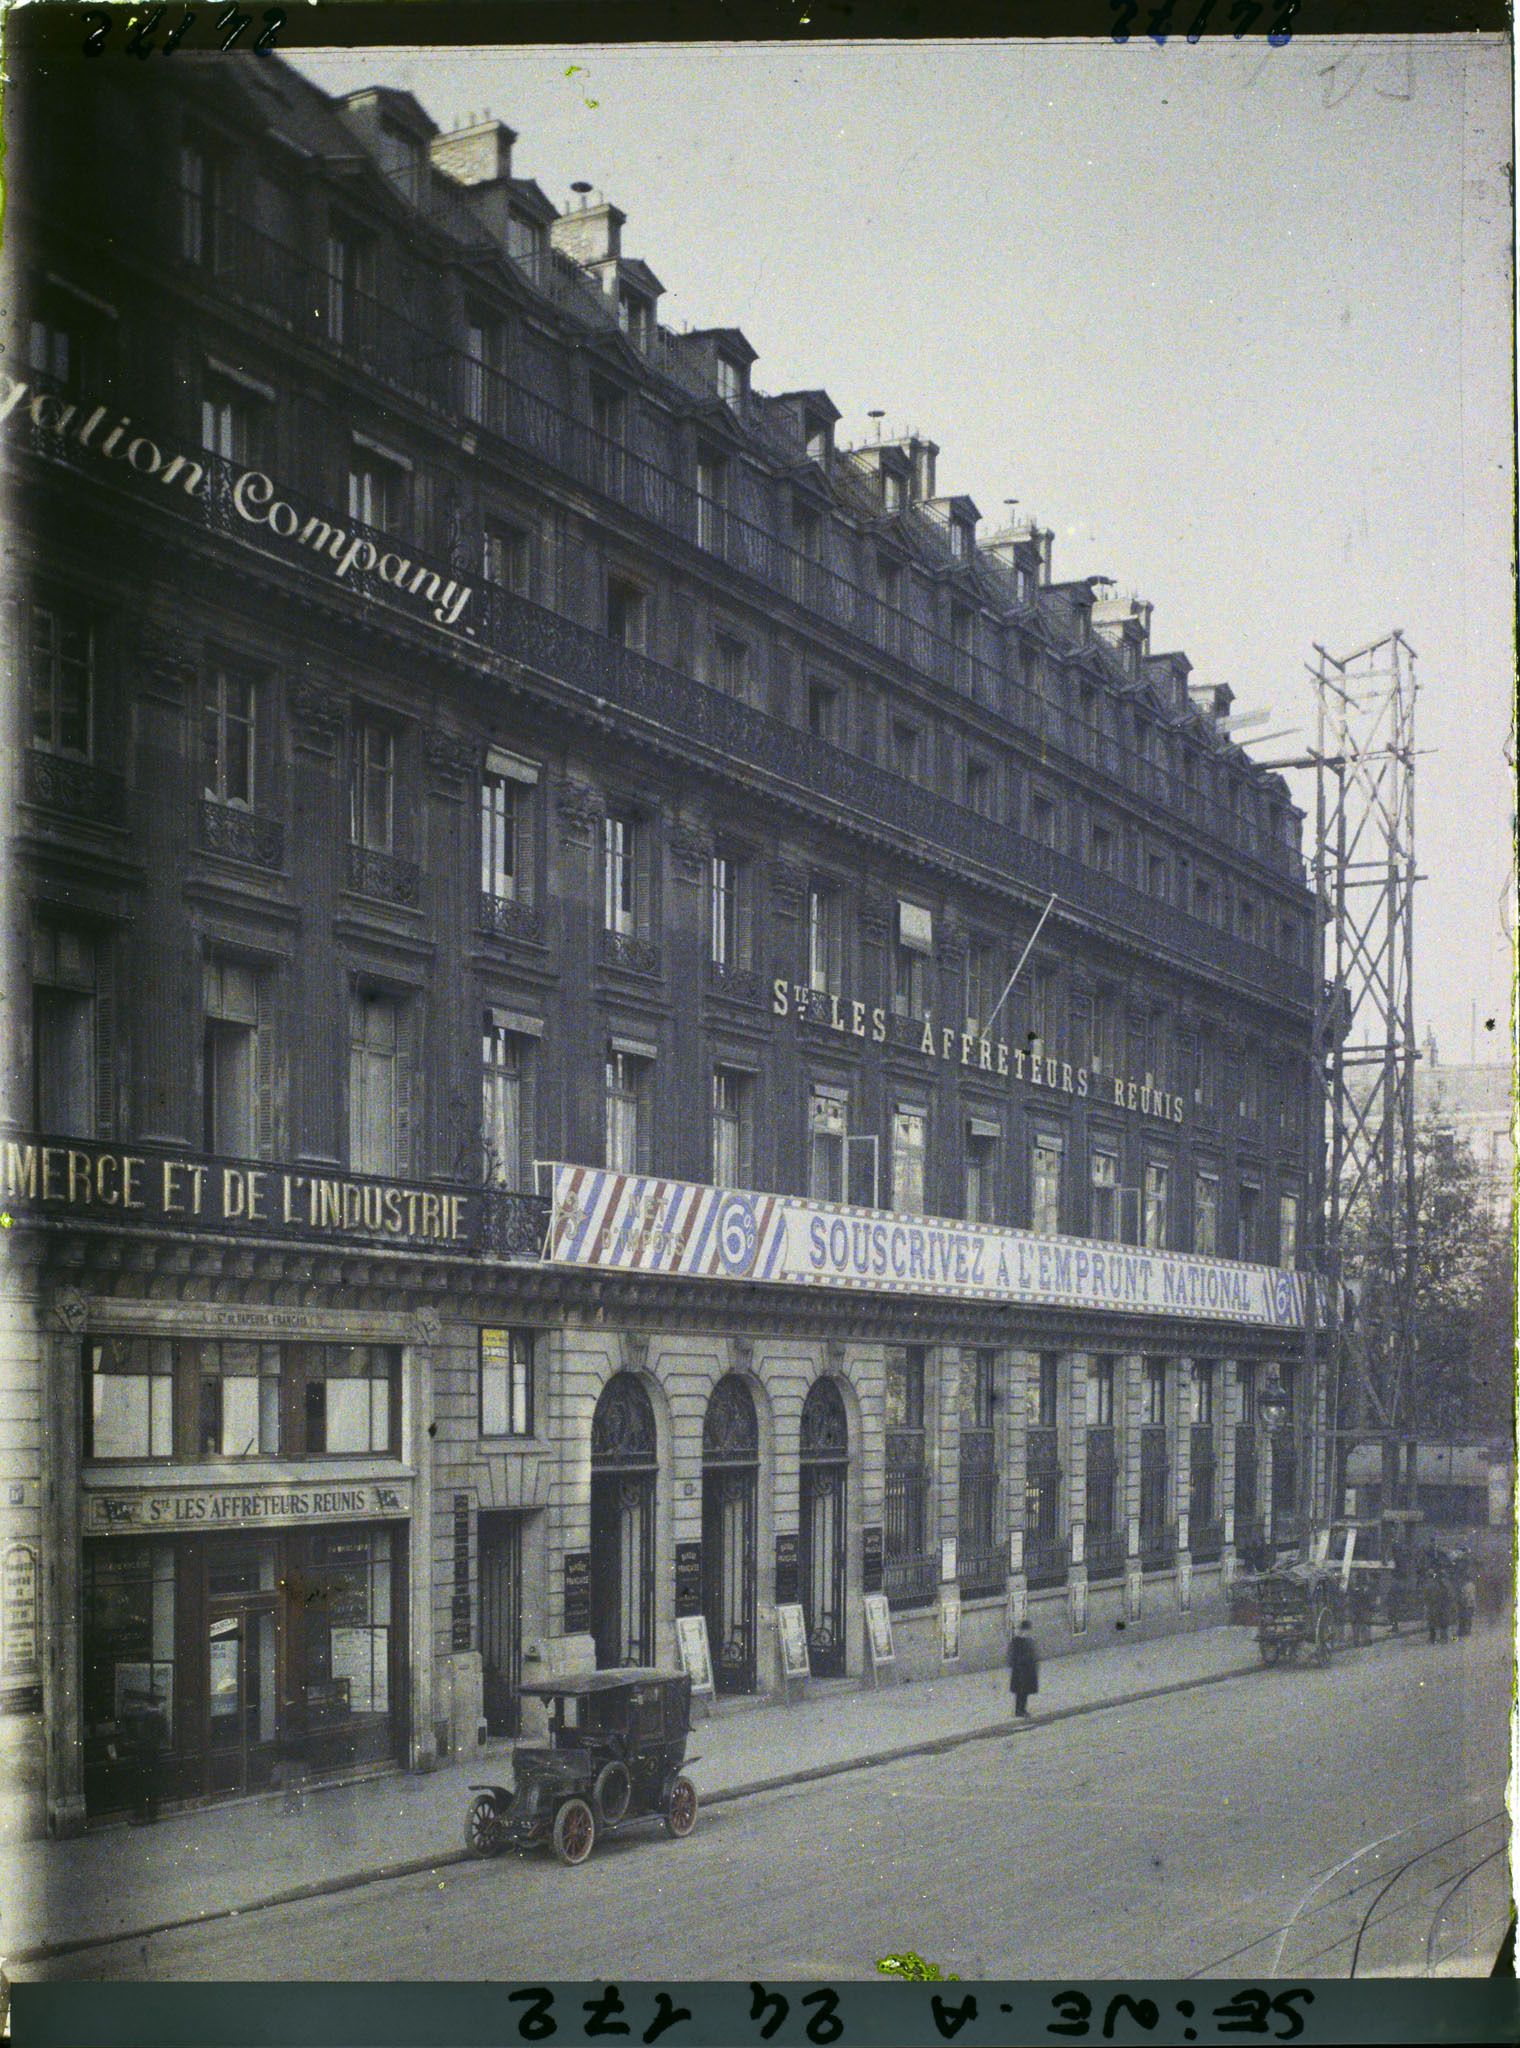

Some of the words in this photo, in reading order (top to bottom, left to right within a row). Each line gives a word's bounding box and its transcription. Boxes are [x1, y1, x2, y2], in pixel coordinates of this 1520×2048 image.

[830, 994, 887, 1043] LES
[163, 1160, 209, 1214] ET
[223, 1168, 268, 1221] DE
[283, 1174, 469, 1240] L'INDUSTRIE
[810, 1215, 985, 1285] SOUSCRIVEZ
[1018, 1241, 1153, 1301] L'EMPRUNT
[1162, 1262, 1251, 1311] NATIONAL
[175, 1498, 206, 1520] LES
[748, 1981, 844, 2043] 24
